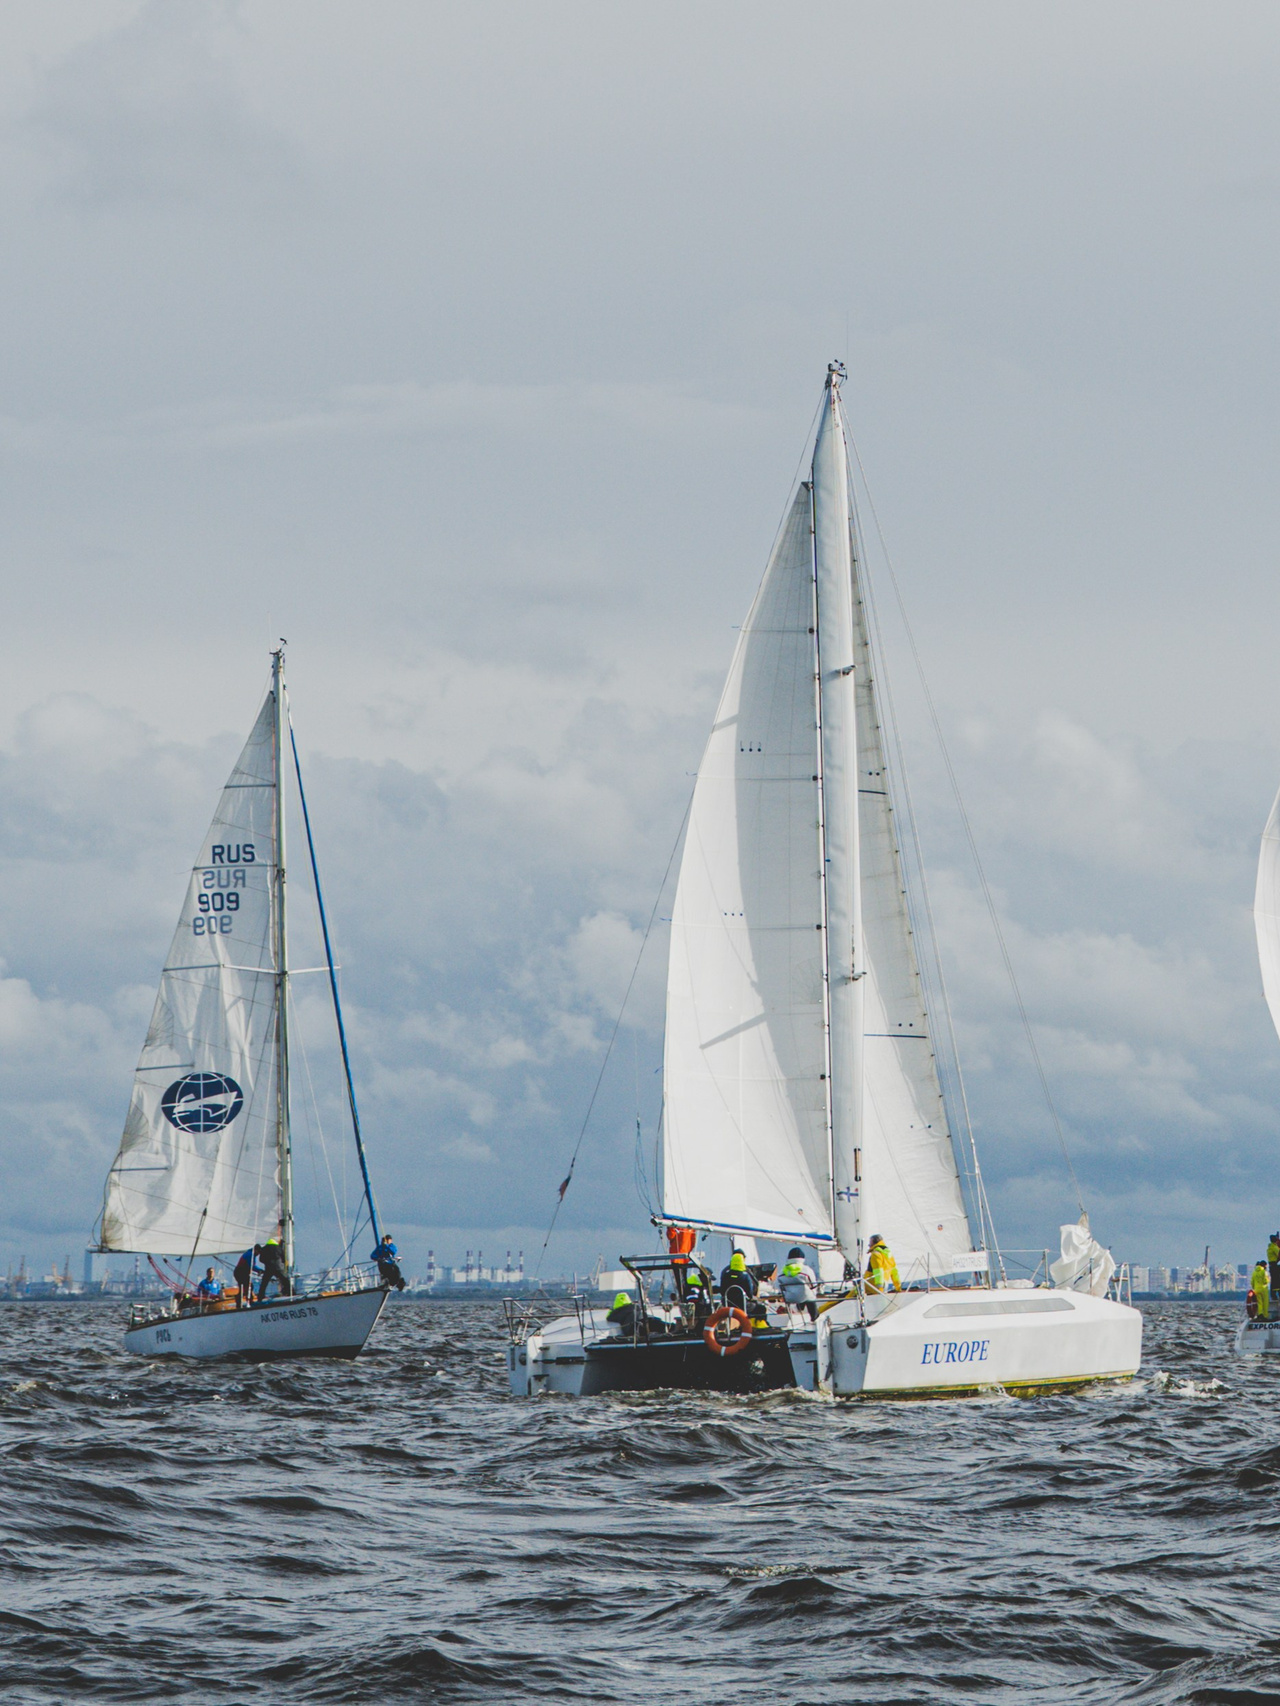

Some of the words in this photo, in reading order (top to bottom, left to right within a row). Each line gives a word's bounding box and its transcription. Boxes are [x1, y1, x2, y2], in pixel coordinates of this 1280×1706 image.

[212, 844, 256, 864] RUS
[198, 892, 240, 913] 909
[261, 1313, 271, 1323] AK
[272, 1312, 289, 1322] 0746
[289, 1308, 308, 1320] RUS
[307, 1307, 319, 1317] 78
[920, 1340, 990, 1364] EUROPE
